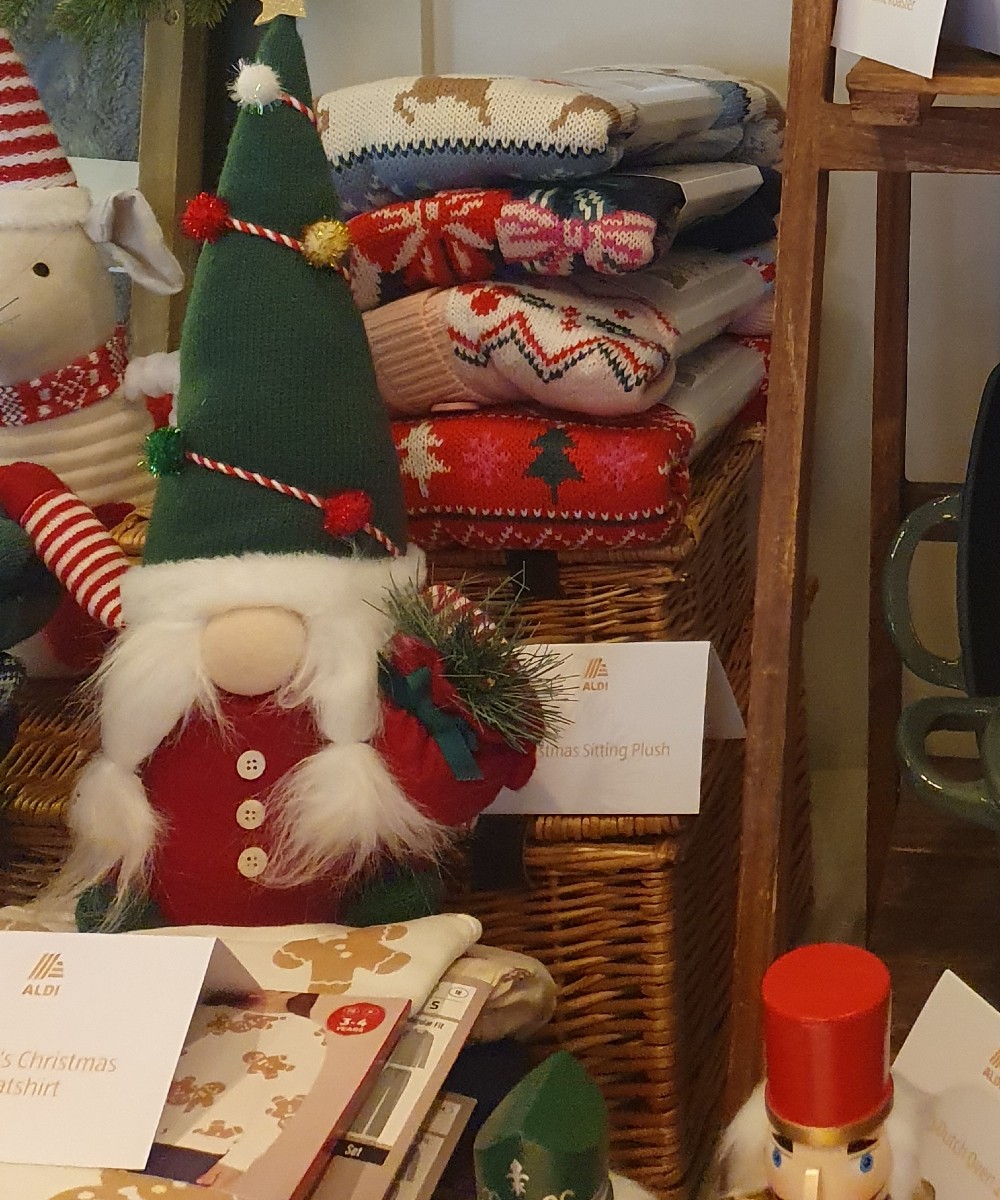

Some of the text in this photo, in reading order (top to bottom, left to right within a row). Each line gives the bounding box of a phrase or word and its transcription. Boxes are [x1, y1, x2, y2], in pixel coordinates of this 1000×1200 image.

[582, 681, 608, 691] ALDI
[582, 742, 628, 761] Sitting
[631, 741, 670, 757] Plush
[21, 985, 61, 996] ALDI
[430, 1000, 440, 1009] S
[17, 1050, 118, 1073] Christmas
